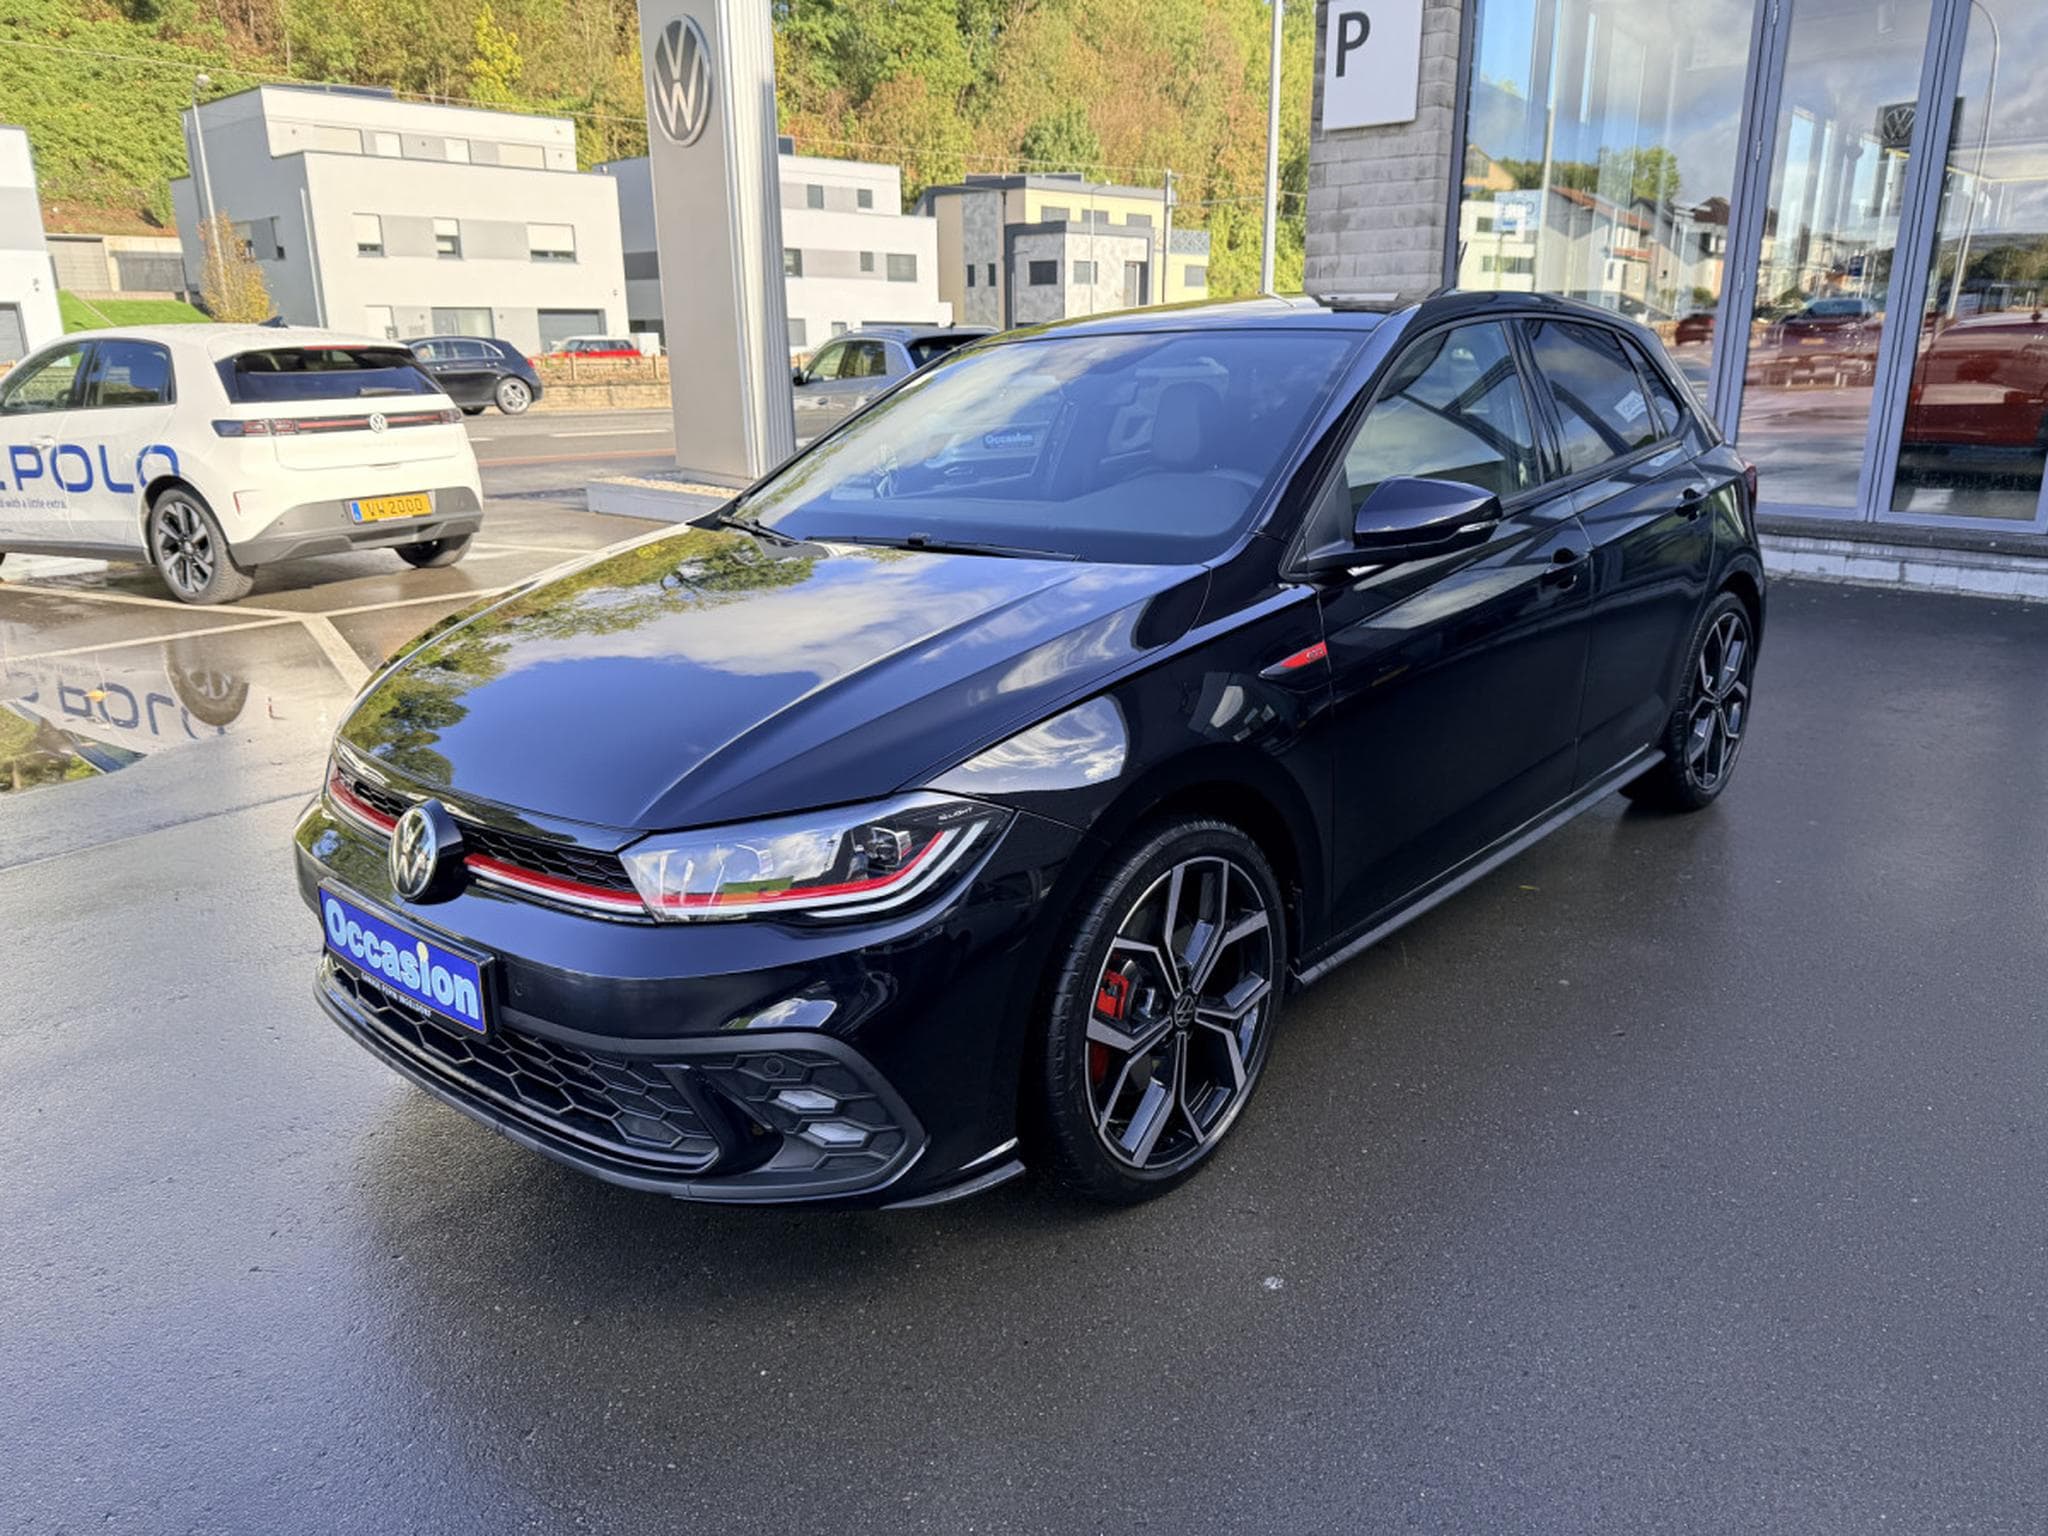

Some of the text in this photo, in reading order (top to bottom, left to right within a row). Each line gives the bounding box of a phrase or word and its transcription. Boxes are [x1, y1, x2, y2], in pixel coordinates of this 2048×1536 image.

[1336, 11, 1371, 78] P
[388, 498, 423, 514] 2000
[325, 898, 480, 1021] Occasion
